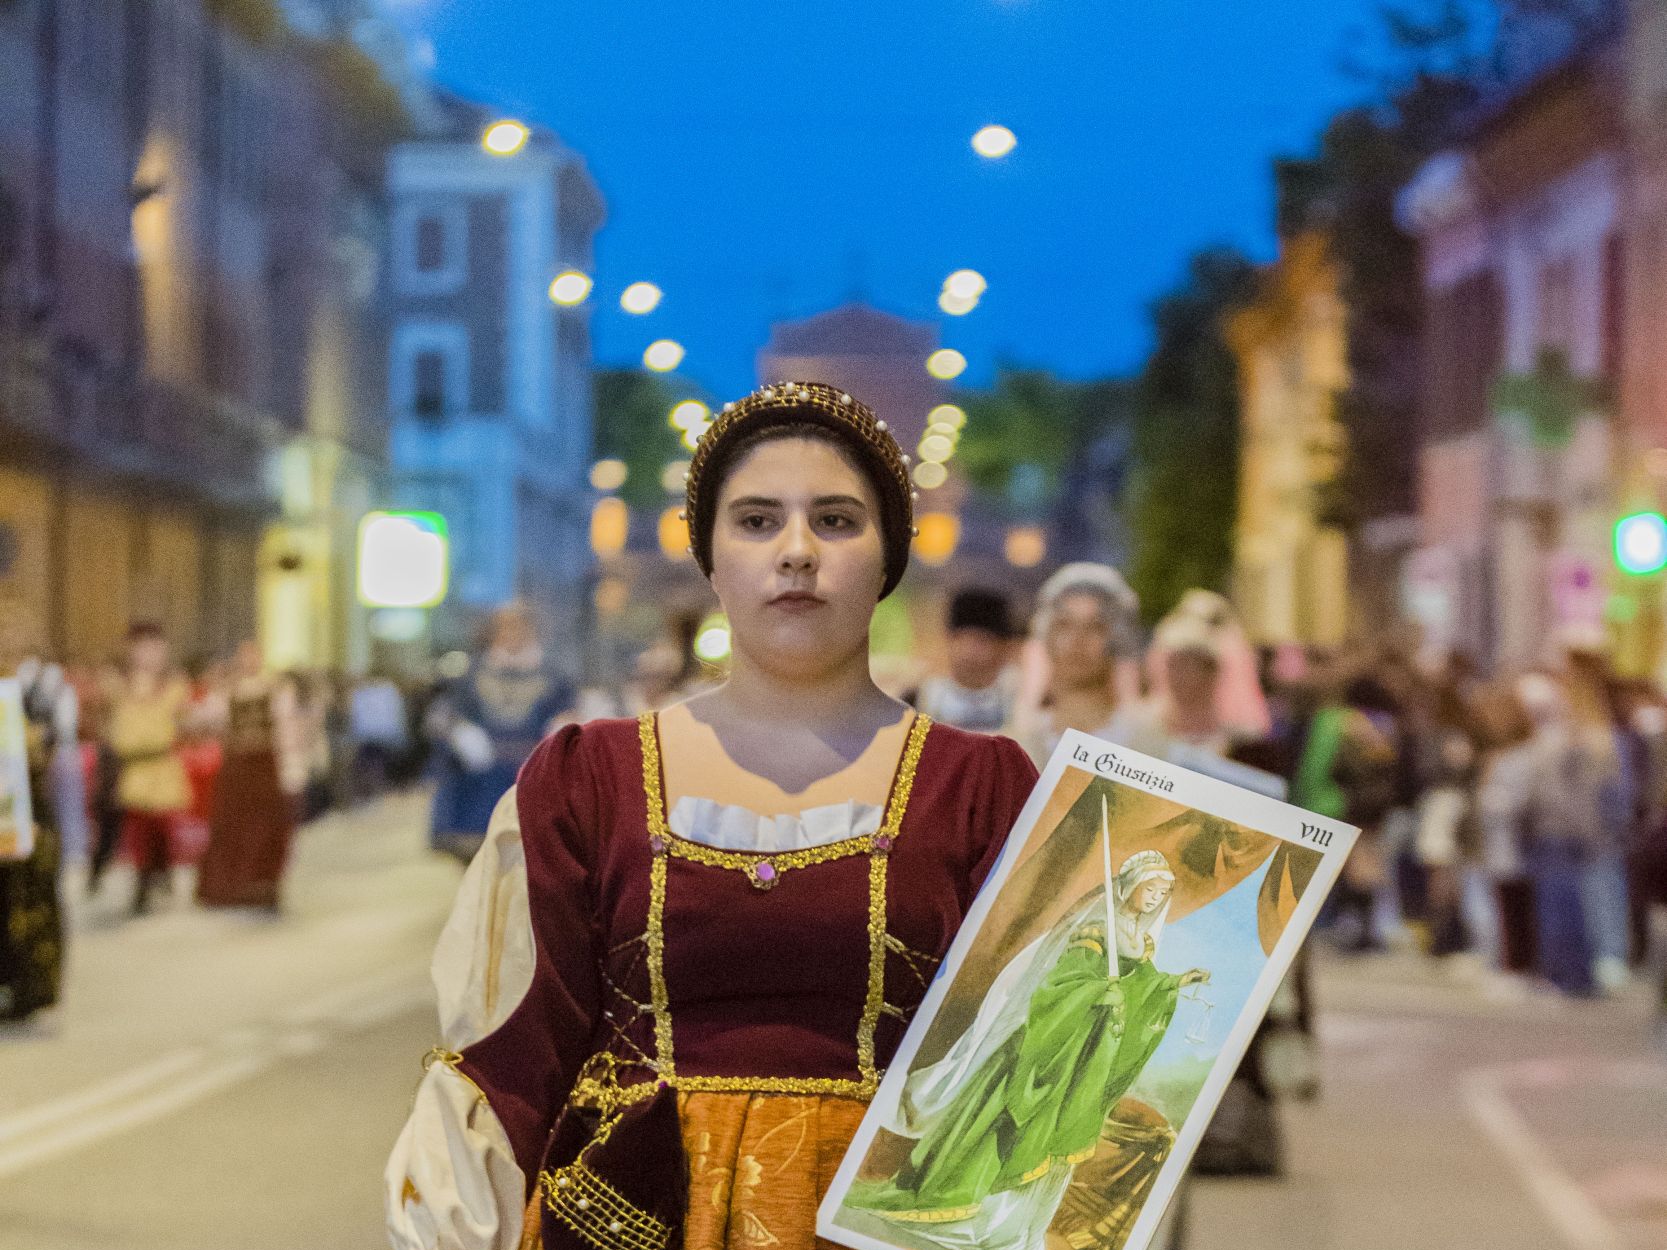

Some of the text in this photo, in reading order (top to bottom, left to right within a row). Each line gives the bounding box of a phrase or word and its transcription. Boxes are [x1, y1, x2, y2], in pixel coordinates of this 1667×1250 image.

[1072, 743, 1175, 794] la Giustizia
[1300, 822, 1334, 847] VIII
